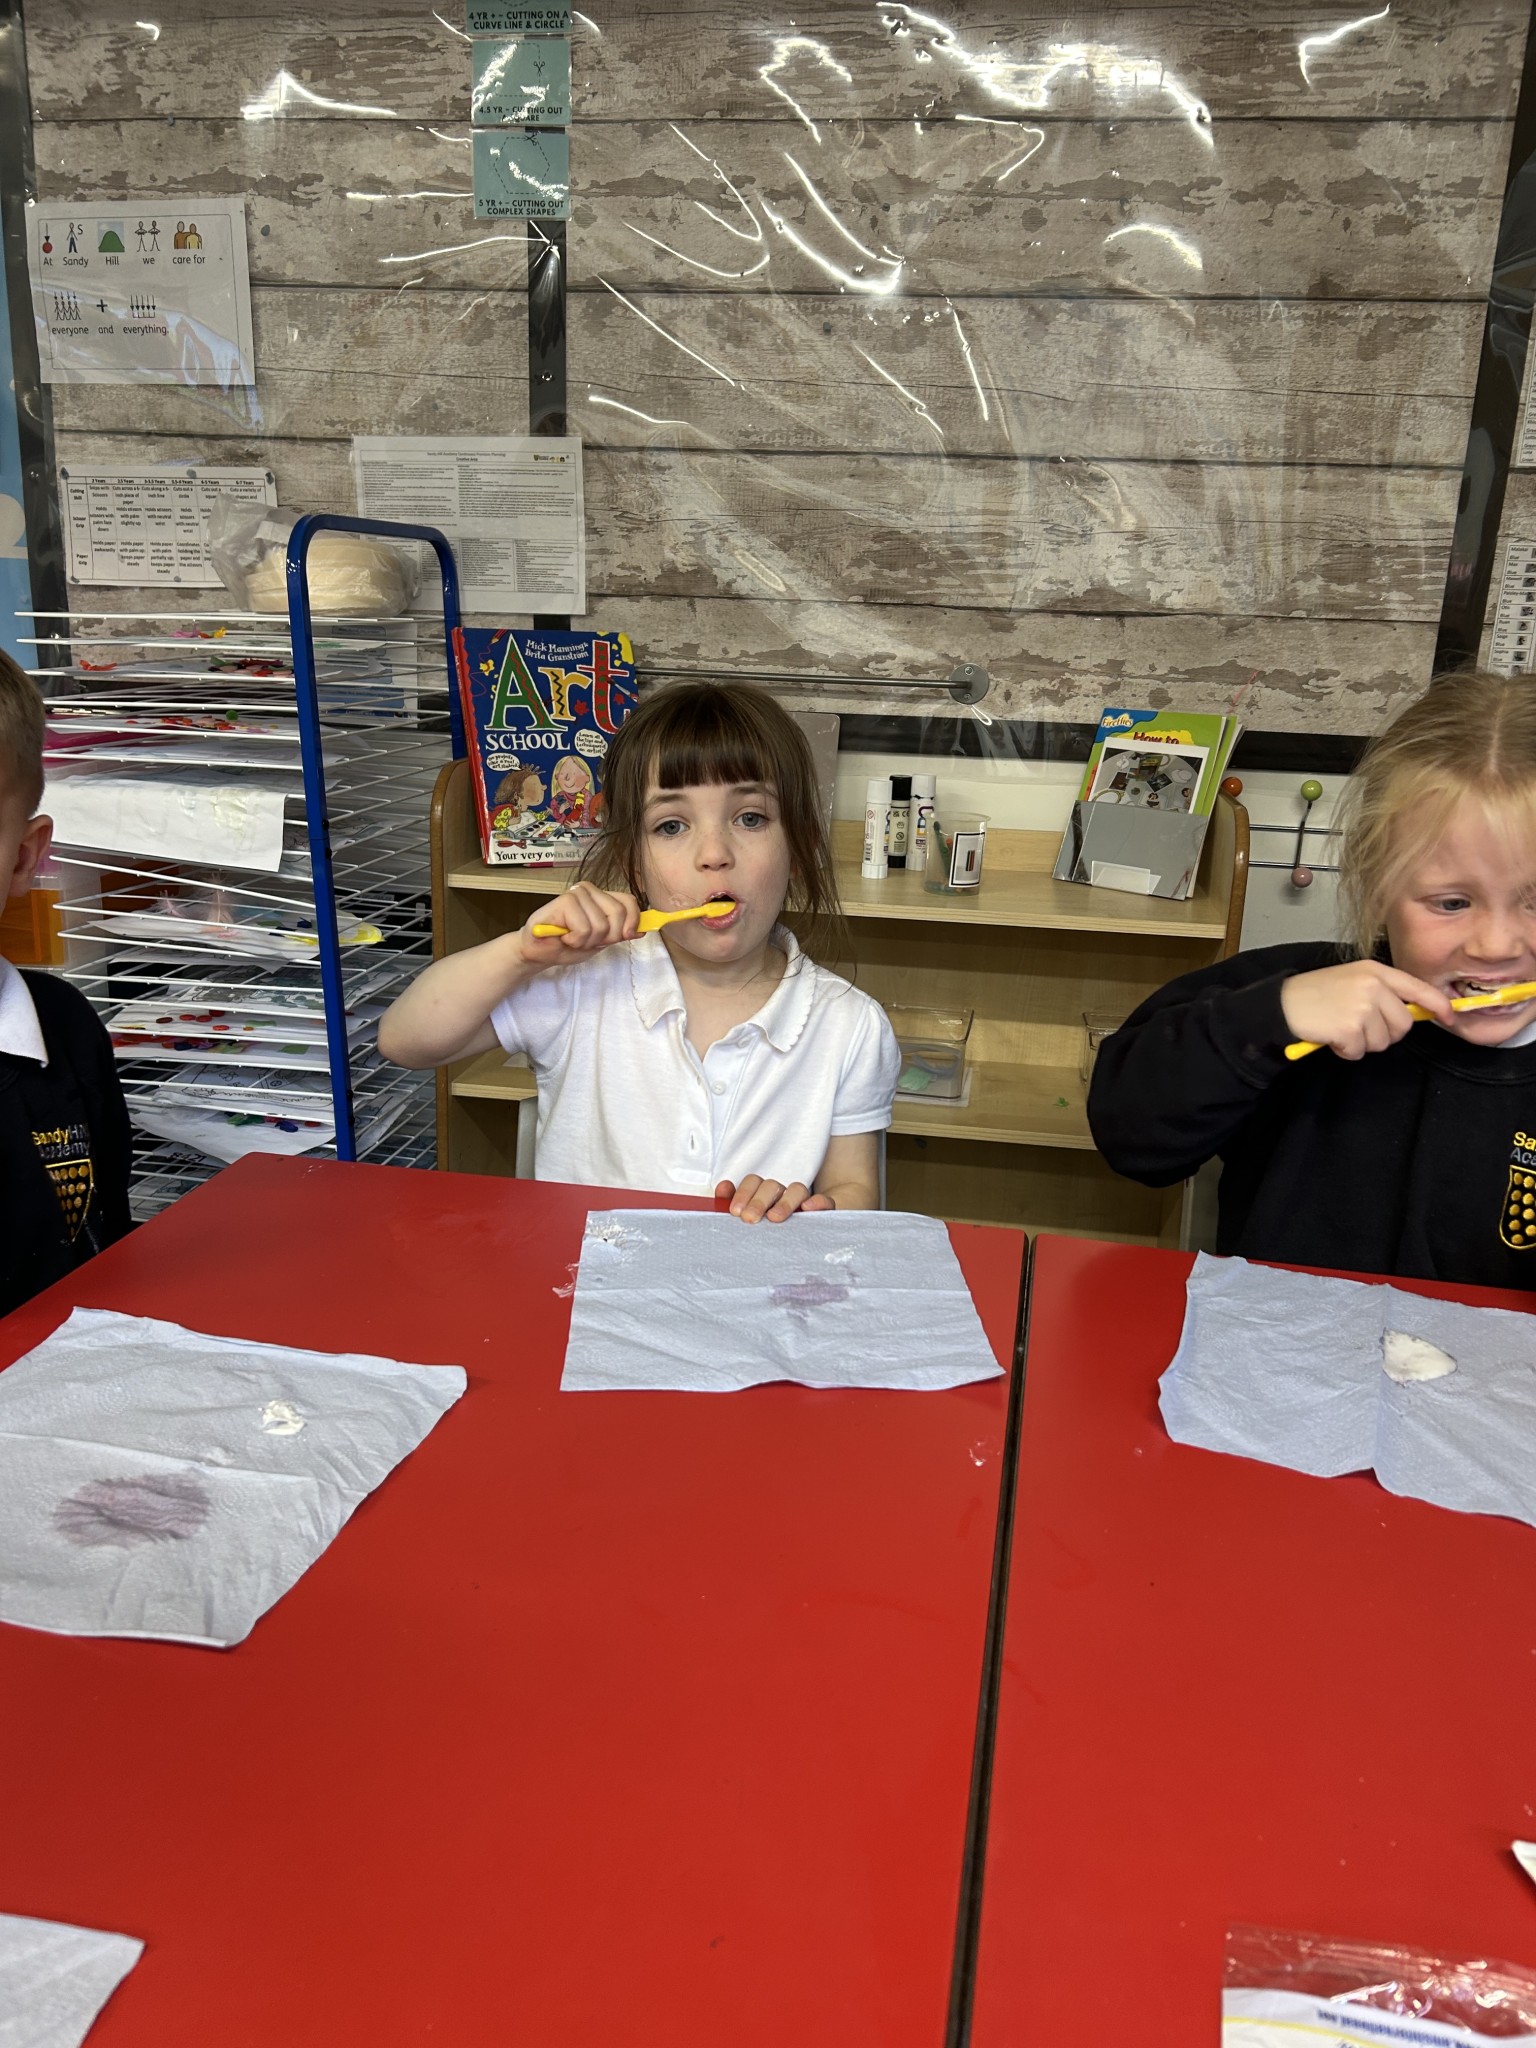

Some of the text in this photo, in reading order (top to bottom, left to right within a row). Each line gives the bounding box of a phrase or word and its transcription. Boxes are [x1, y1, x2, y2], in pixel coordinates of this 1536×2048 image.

[506, 11, 544, 19] CUTTING
[535, 20, 564, 28] CIRCLE
[511, 114, 540, 122] QUARE
[44, 257, 53, 266] At
[63, 257, 89, 267] Sandy
[105, 257, 119, 265] Hill
[193, 254, 206, 264] for
[52, 325, 169, 336] everyone and everything.
[526, 640, 547, 651] Mick
[525, 648, 545, 659] Brita
[484, 633, 630, 734] Art
[1102, 715, 1133, 727] Fireflies
[486, 733, 570, 751] SCHOOL
[1133, 732, 1180, 744] How to
[495, 851, 518, 861] Your
[520, 851, 543, 861] very
[1514, 1132, 1536, 1151] Sa
